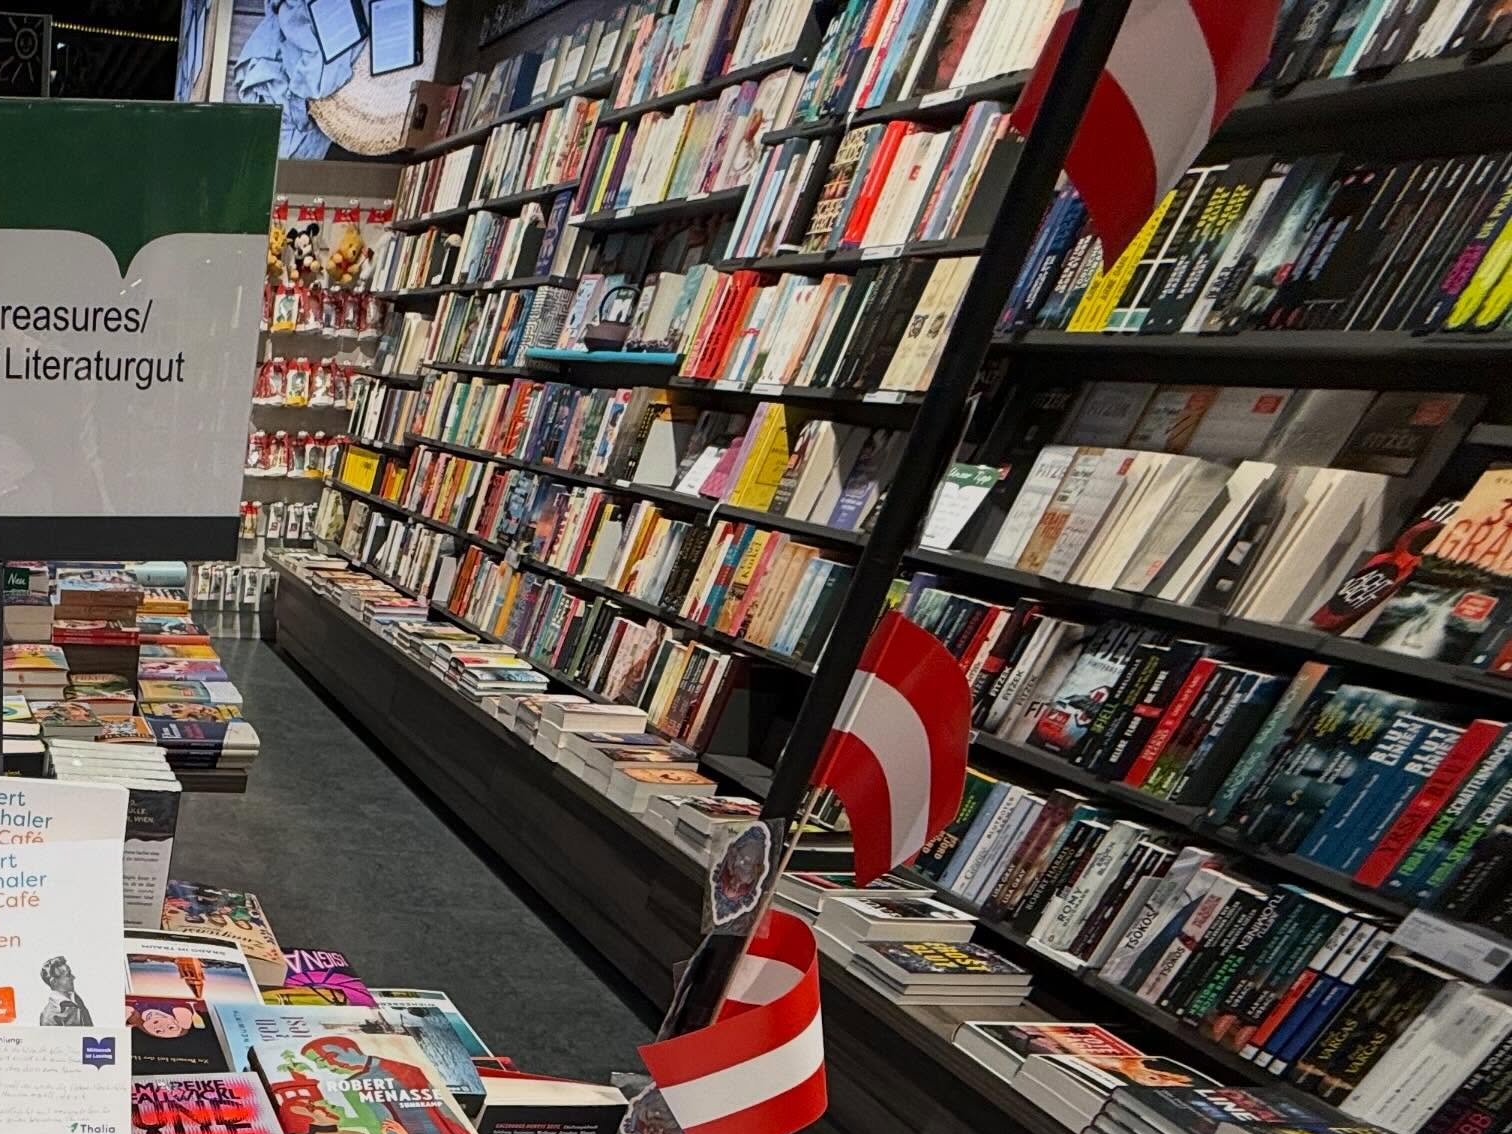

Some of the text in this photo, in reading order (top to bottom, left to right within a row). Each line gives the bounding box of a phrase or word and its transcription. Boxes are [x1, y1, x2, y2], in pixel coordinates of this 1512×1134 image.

[3, 344, 186, 391] Literaturgut
[7, 573, 27, 587] Neu
[990, 665, 1012, 698] FITZEK
[1002, 670, 1025, 701] FITZEK
[1057, 886, 1083, 922] ROMY
[1125, 911, 1159, 951] TSOKOS
[1238, 893, 1285, 951] TUOMINEN
[1159, 945, 1186, 977] TSOKOS
[1345, 1031, 1387, 1075] VARGAS
[135, 1079, 224, 1092] MAREIKE
[326, 1078, 395, 1093] ROBERT
[359, 1087, 443, 1103] MENASSE
[1194, 1088, 1257, 1122] LINE
[80, 1123, 117, 1134] Thalia
